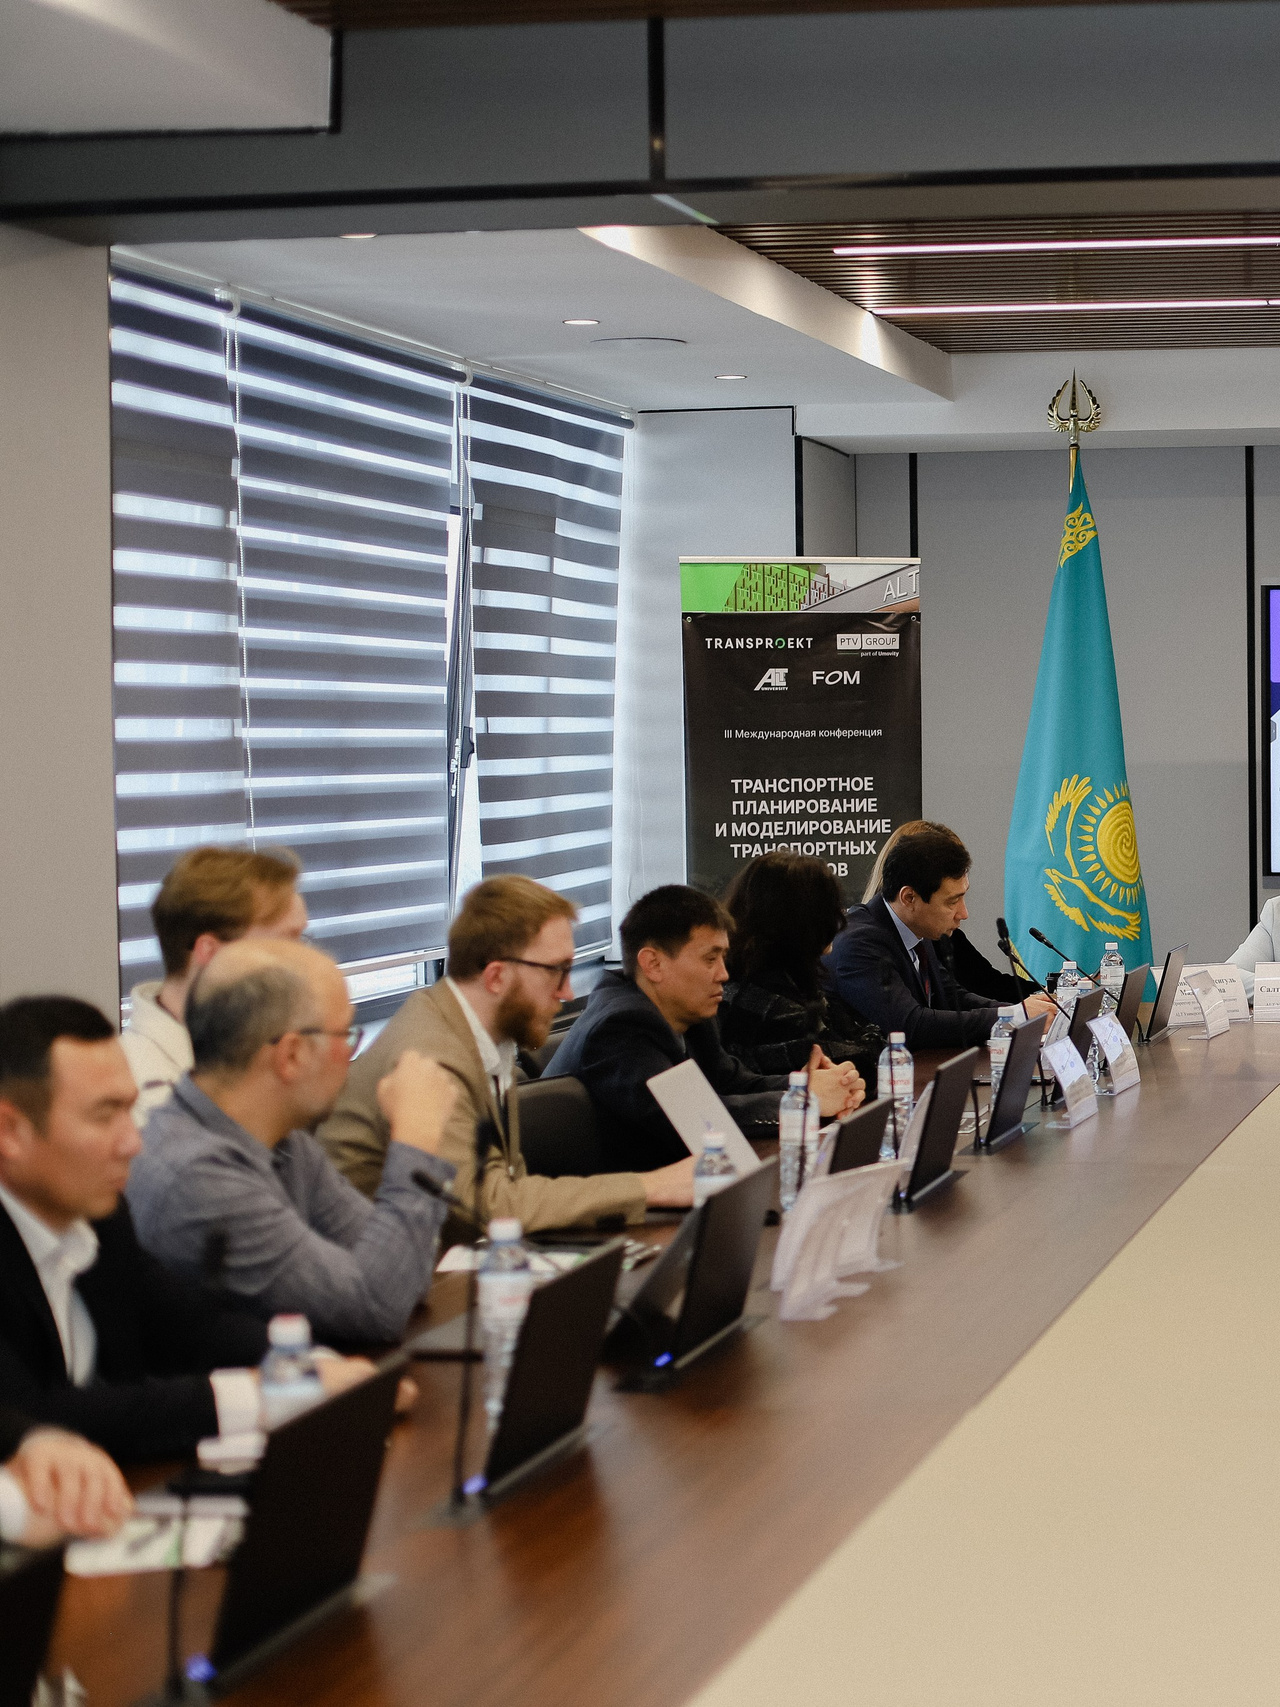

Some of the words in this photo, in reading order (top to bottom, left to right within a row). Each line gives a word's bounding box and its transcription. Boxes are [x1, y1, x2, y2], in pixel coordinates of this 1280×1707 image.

[705, 637, 814, 649] TRANSPROEKT
[840, 638, 858, 646] PTV
[865, 637, 897, 646] GROUP
[812, 670, 860, 685] FOM
[735, 729, 816, 740] Международная
[818, 728, 882, 738] конференция
[731, 776, 874, 794] ТРАНСПОРТНОЕ
[732, 798, 878, 816] ПЛАНИРОВАНИЕ
[715, 823, 727, 838] И
[732, 819, 892, 840] МОДЕЛИРОВАНИЕ
